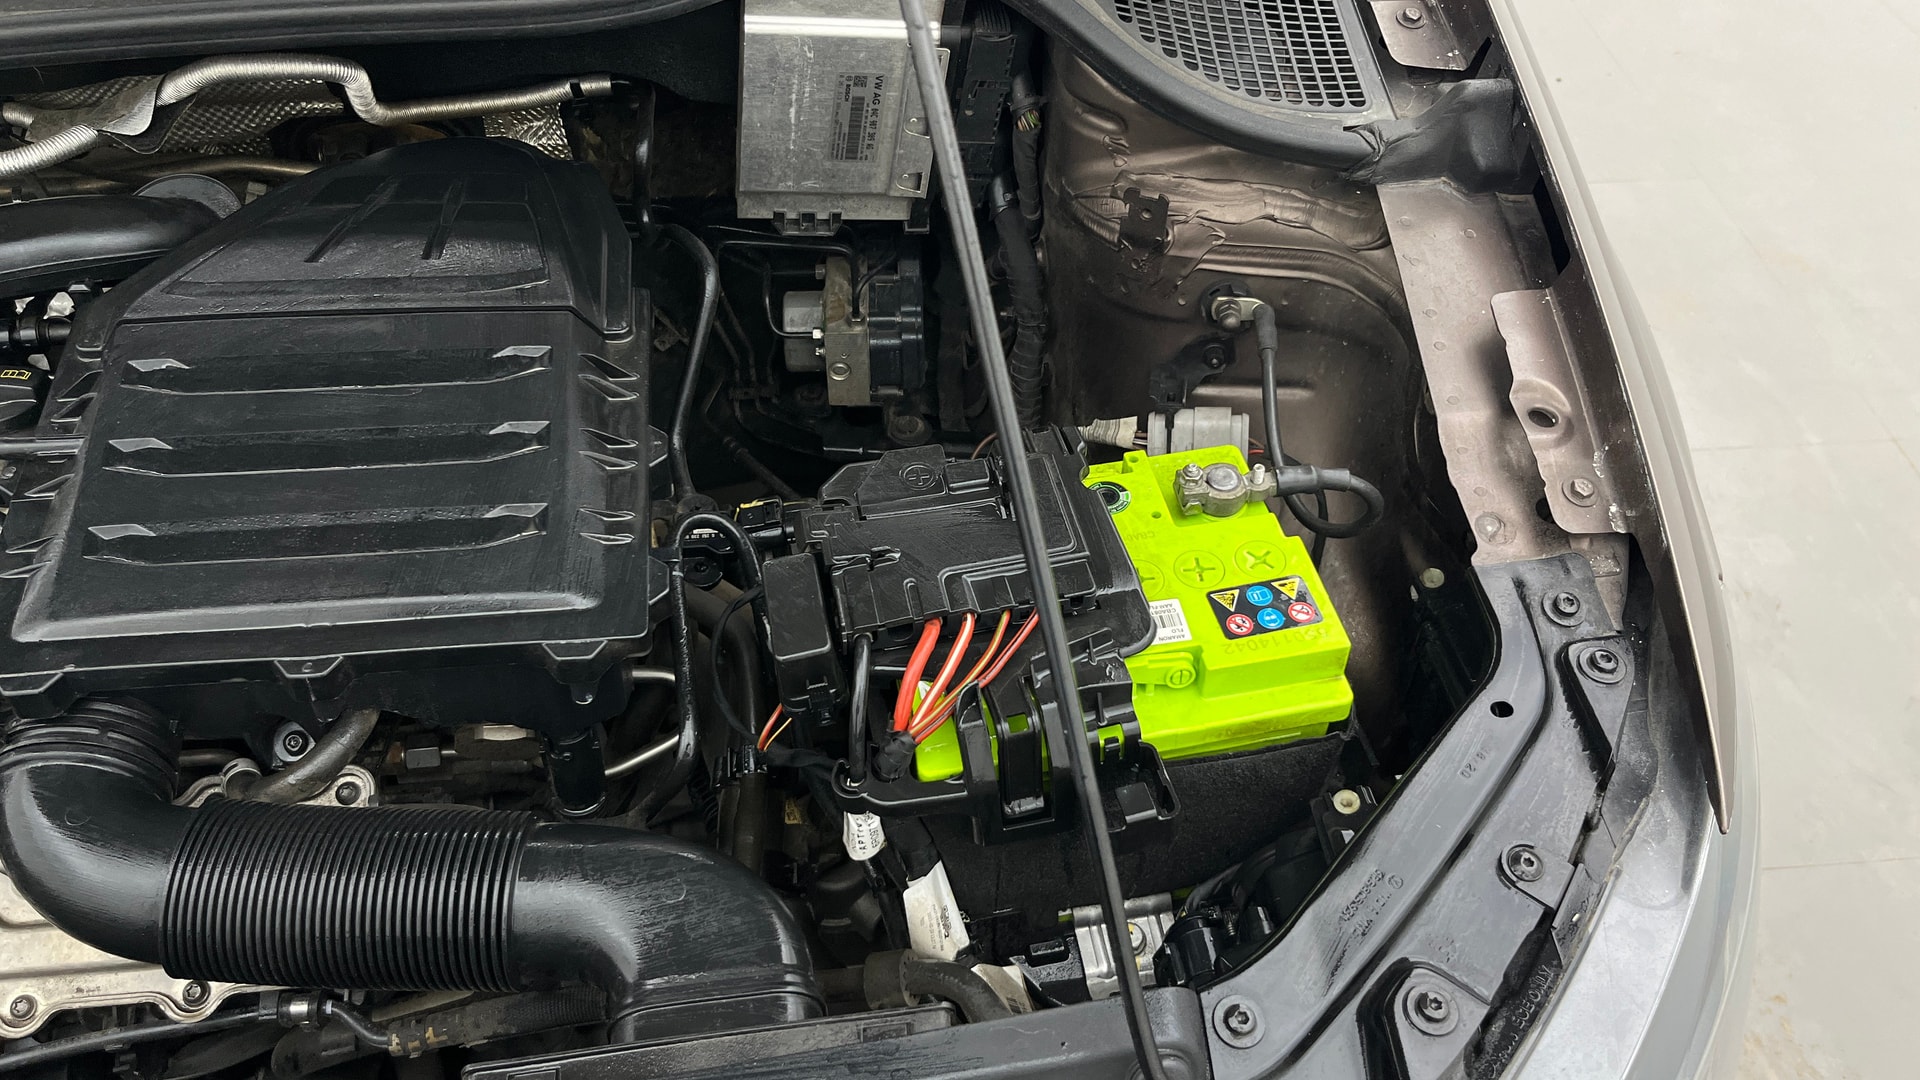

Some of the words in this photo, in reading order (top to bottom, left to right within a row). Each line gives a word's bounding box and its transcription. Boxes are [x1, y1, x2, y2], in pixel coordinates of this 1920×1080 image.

[874, 75, 883, 90] VW
[872, 92, 881, 105] AG
[1158, 633, 1185, 641] AMARON
